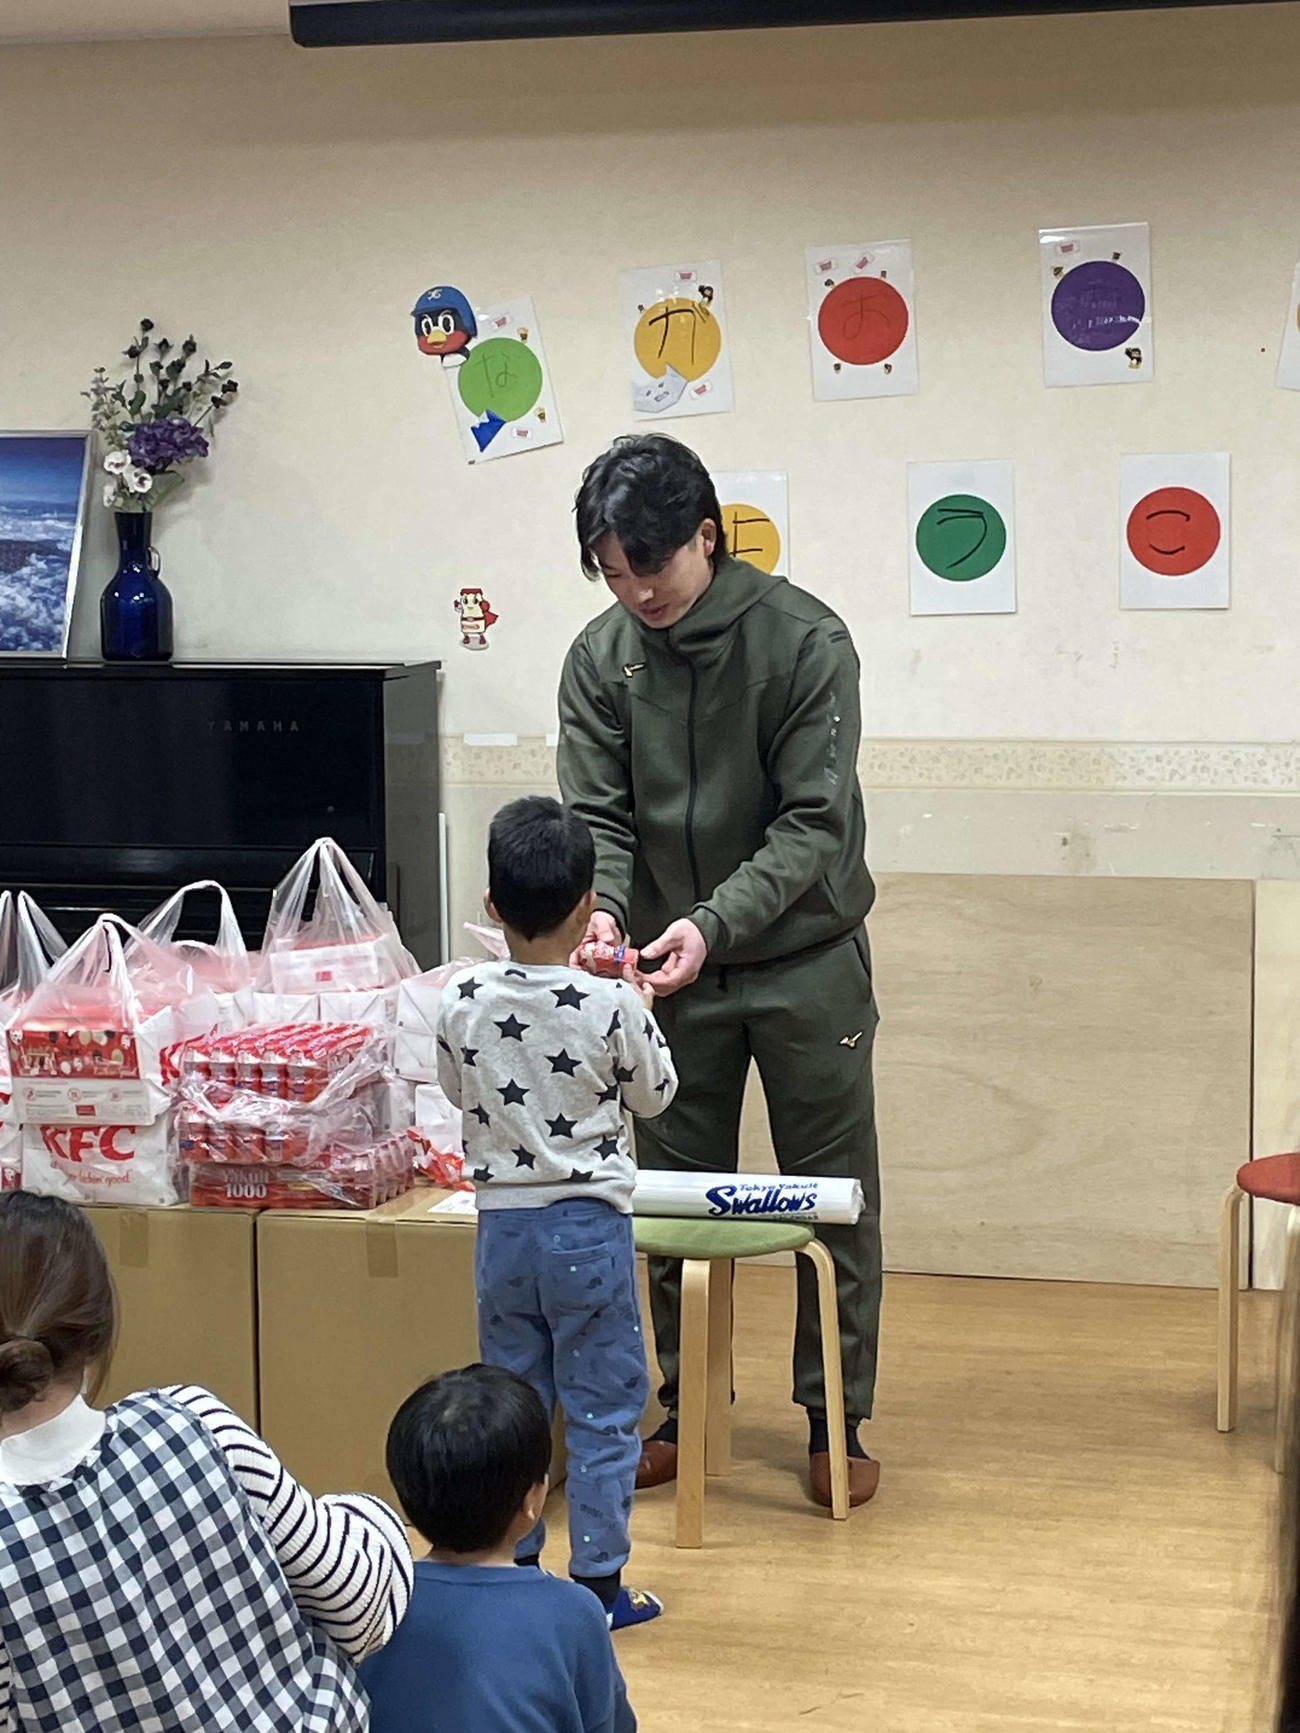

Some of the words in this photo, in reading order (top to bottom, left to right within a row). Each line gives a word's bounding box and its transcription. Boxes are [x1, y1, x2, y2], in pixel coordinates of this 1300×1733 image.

[207, 720, 299, 732] YAMAHA
[40, 1124, 137, 1162] KFC
[225, 1183, 268, 1199] 1000
[739, 1183, 776, 1192] Tokyo
[778, 1182, 819, 1191] Yakult
[705, 1184, 818, 1217] Swallows
